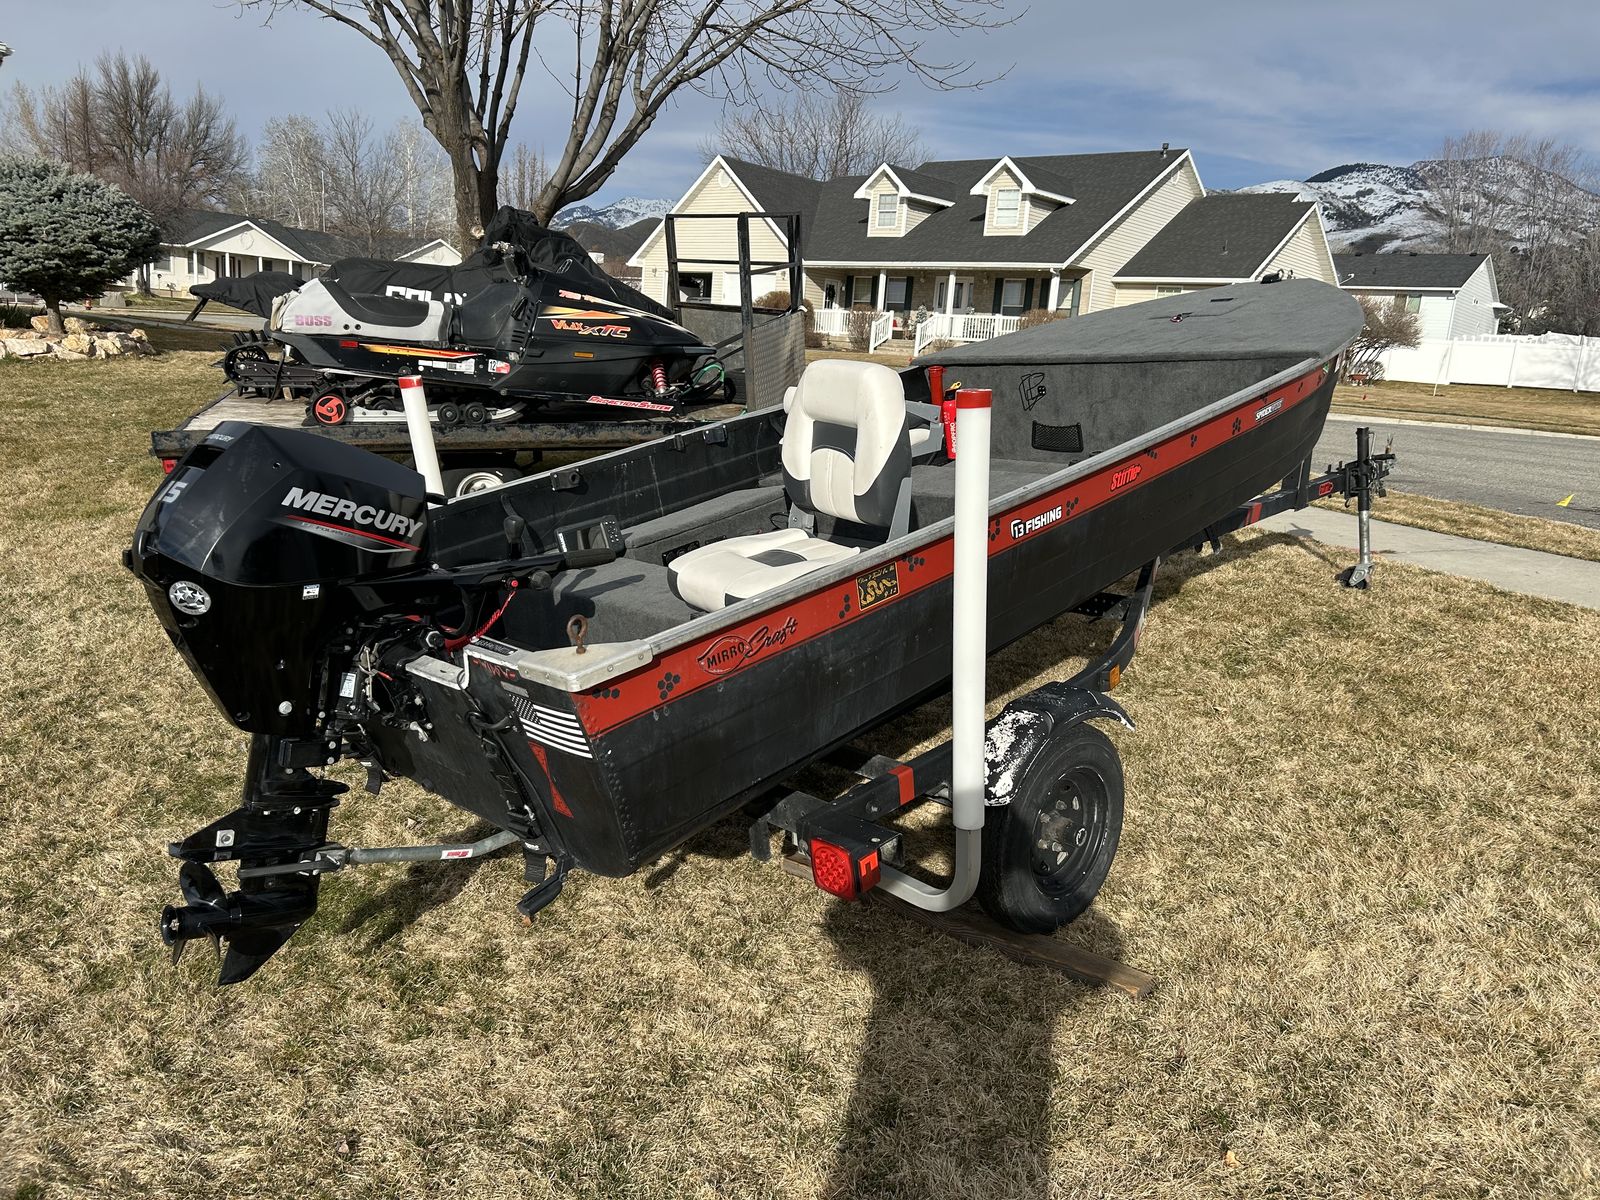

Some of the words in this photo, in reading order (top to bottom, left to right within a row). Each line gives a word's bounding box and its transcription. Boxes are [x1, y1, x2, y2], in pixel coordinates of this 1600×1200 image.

[295, 314, 332, 327] BOSS
[578, 324, 631, 338] XTC
[489, 361, 497, 371] 12
[281, 486, 423, 538] MERCURY
[1011, 520, 1025, 538] 13
[1025, 506, 1062, 534] FISHING
[706, 641, 746, 669] MIRRO
[744, 616, 798, 658] Craft
